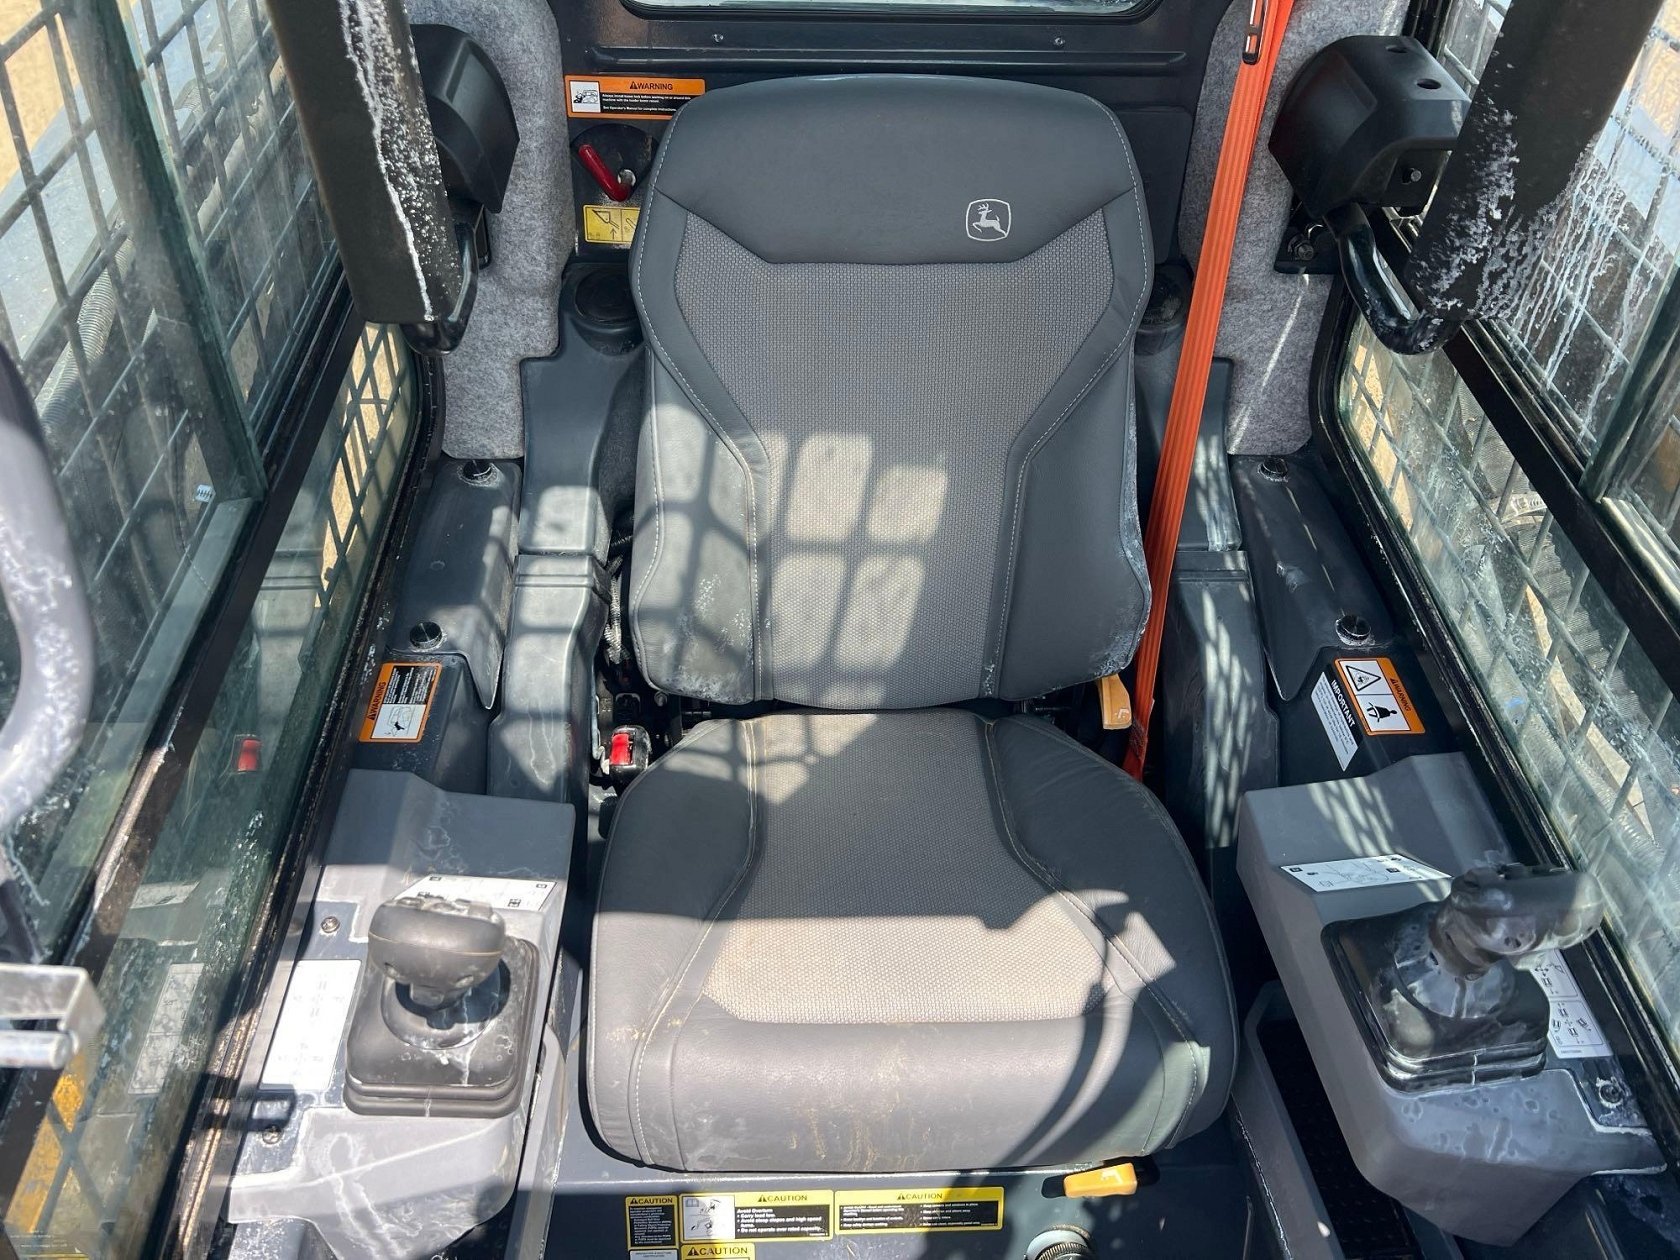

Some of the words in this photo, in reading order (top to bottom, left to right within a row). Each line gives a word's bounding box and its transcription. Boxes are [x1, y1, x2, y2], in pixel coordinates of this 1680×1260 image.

[370, 682, 386, 716] WARNING
[1331, 680, 1355, 727] IMPORTANT
[1392, 682, 1411, 712] WARNING
[700, 1247, 748, 1255] CAUTION
